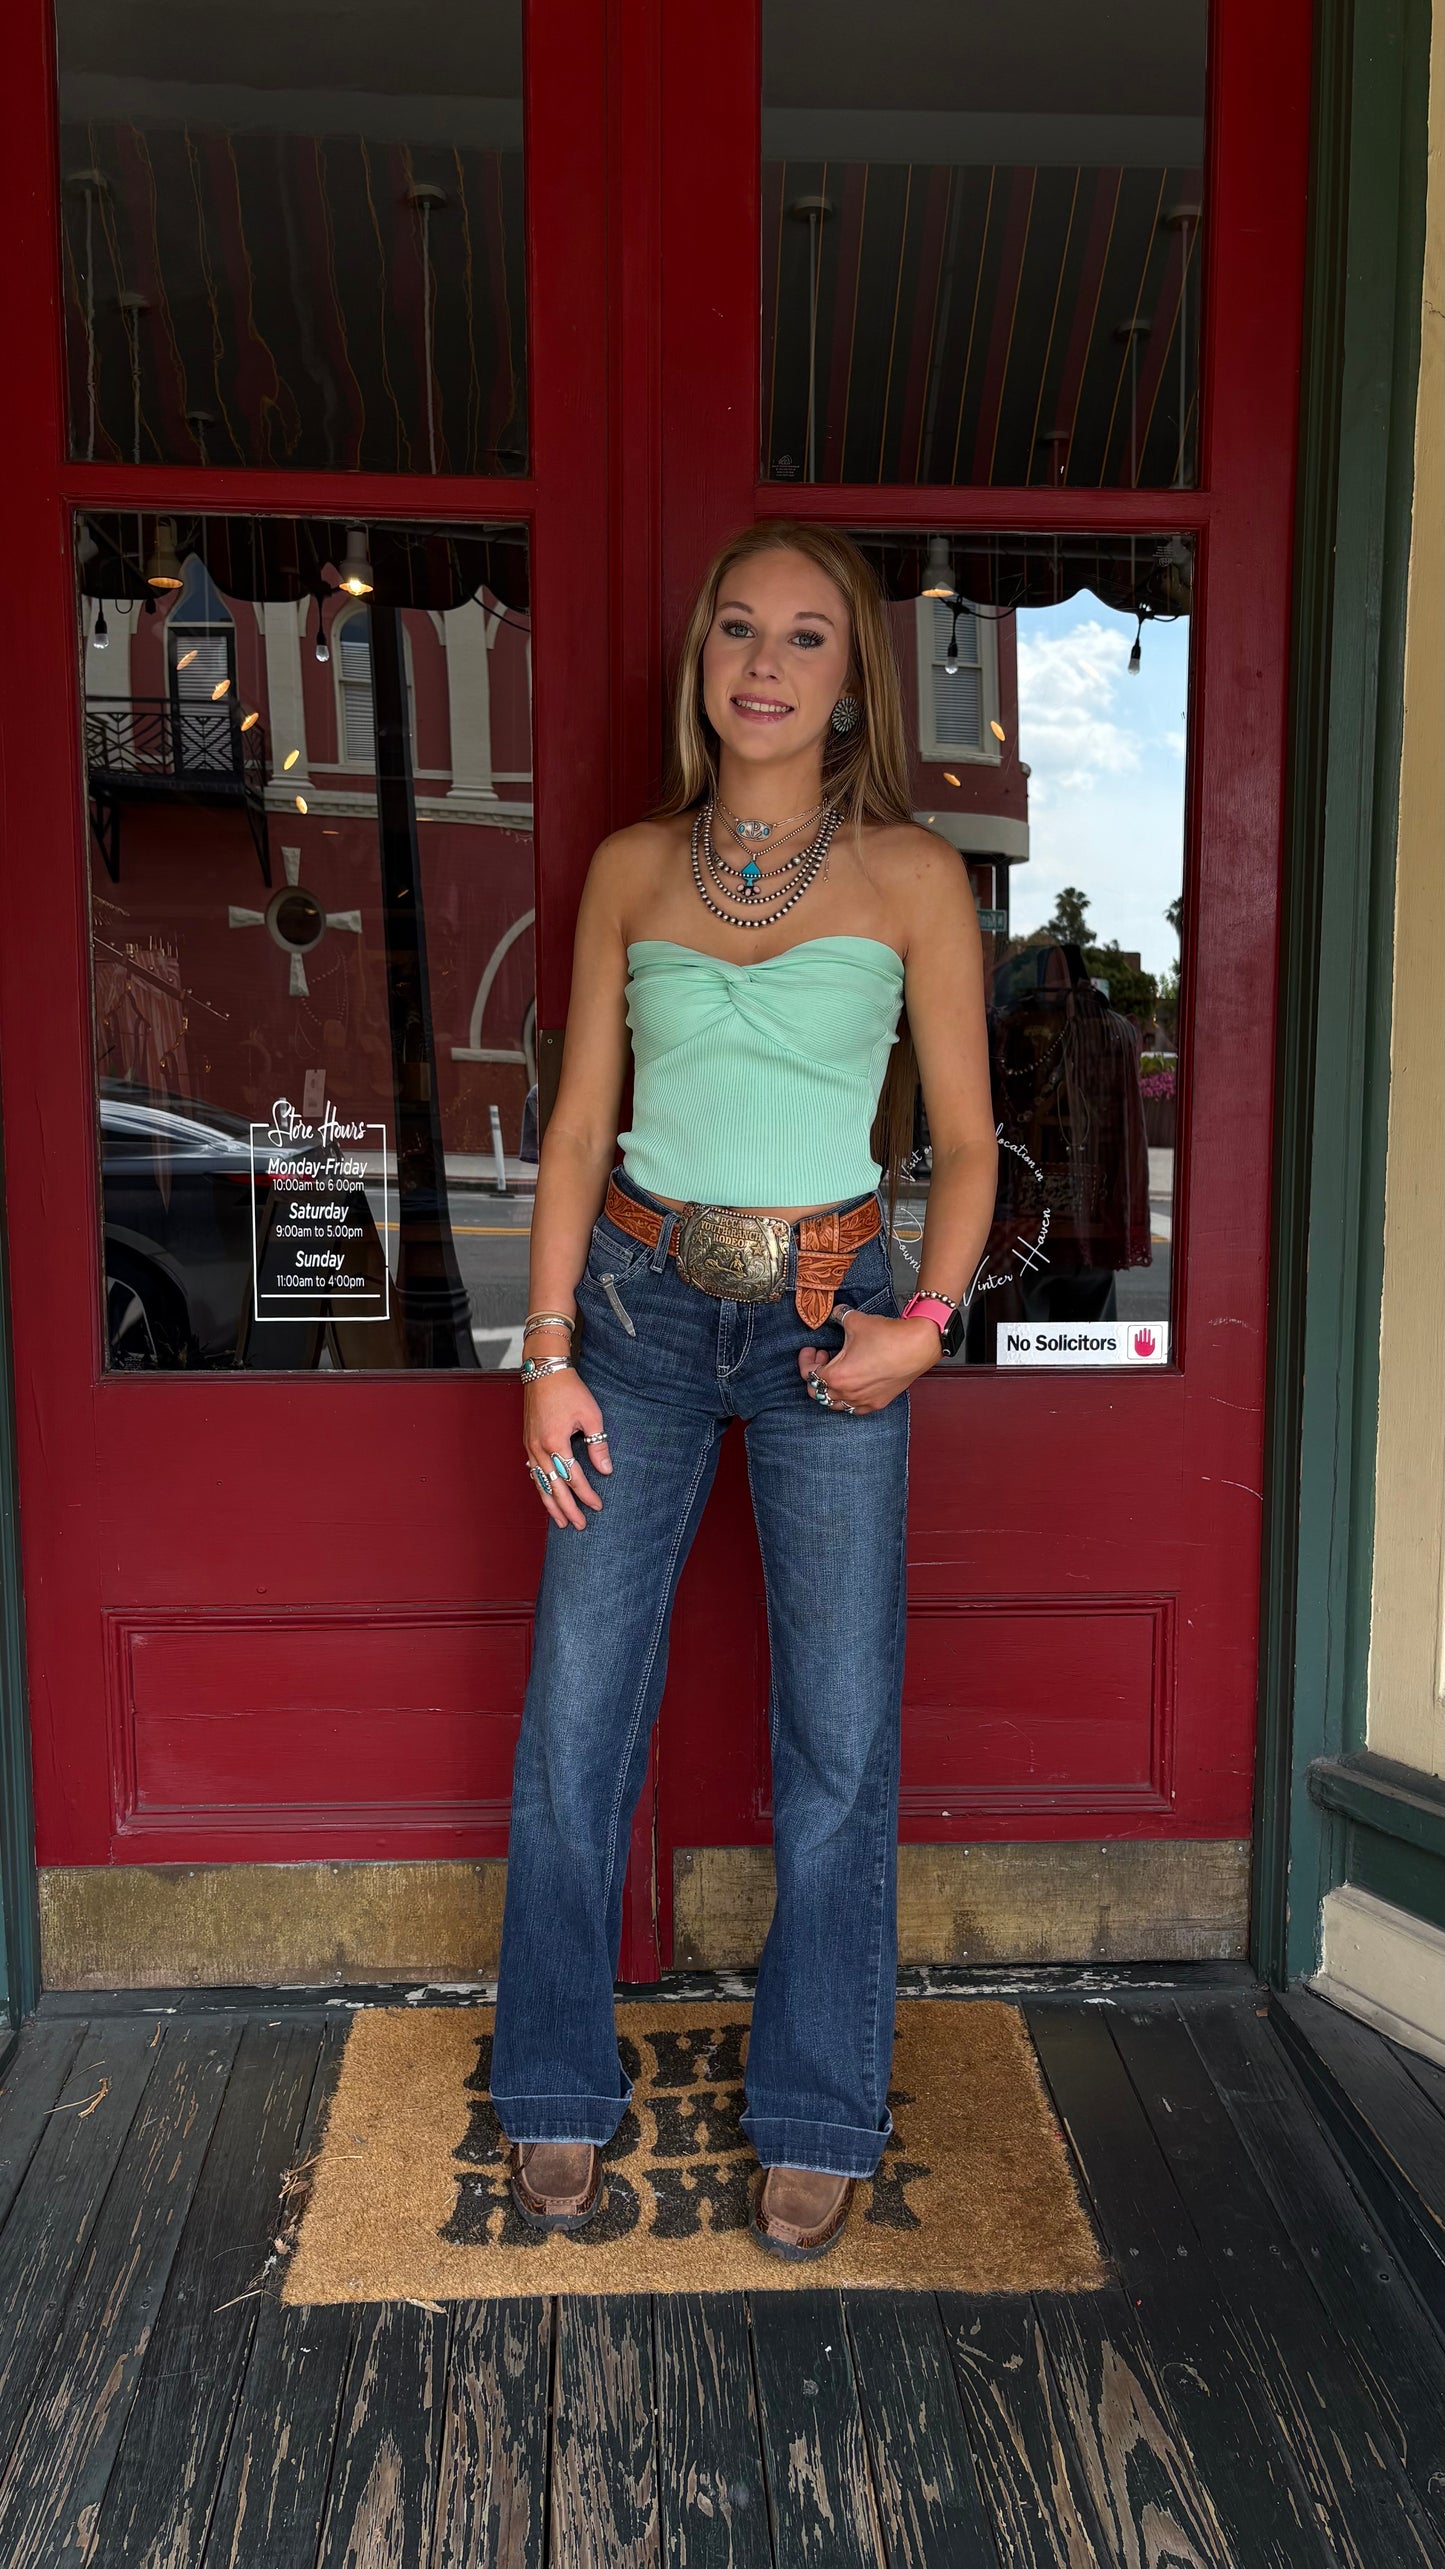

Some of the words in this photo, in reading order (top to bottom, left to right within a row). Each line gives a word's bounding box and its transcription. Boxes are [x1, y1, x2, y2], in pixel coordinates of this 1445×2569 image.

[267, 1100, 314, 1147] Store
[318, 1100, 367, 1148] Hours
[267, 1157, 368, 1179] Monday-Friday
[1034, 1168, 1044, 1182] in
[273, 1179, 313, 1191] 10:00am
[315, 1179, 326, 1191] to
[327, 1179, 365, 1193] 600pm
[289, 1202, 349, 1222] Saturday
[276, 1225, 312, 1238] 9:00am
[314, 1225, 325, 1238] to
[700, 1220, 729, 1236] YOUTH
[730, 1228, 763, 1242] RANCH
[713, 1233, 745, 1248] RODEO
[1012, 1208, 1051, 1278] Haven
[295, 1250, 345, 1270] Sunday
[276, 1275, 313, 1287] 11:00am
[315, 1275, 326, 1287] to
[1007, 1335, 1031, 1351] No
[1035, 1334, 1117, 1351] Solicitors
[438, 2158, 931, 2247] HOWY
